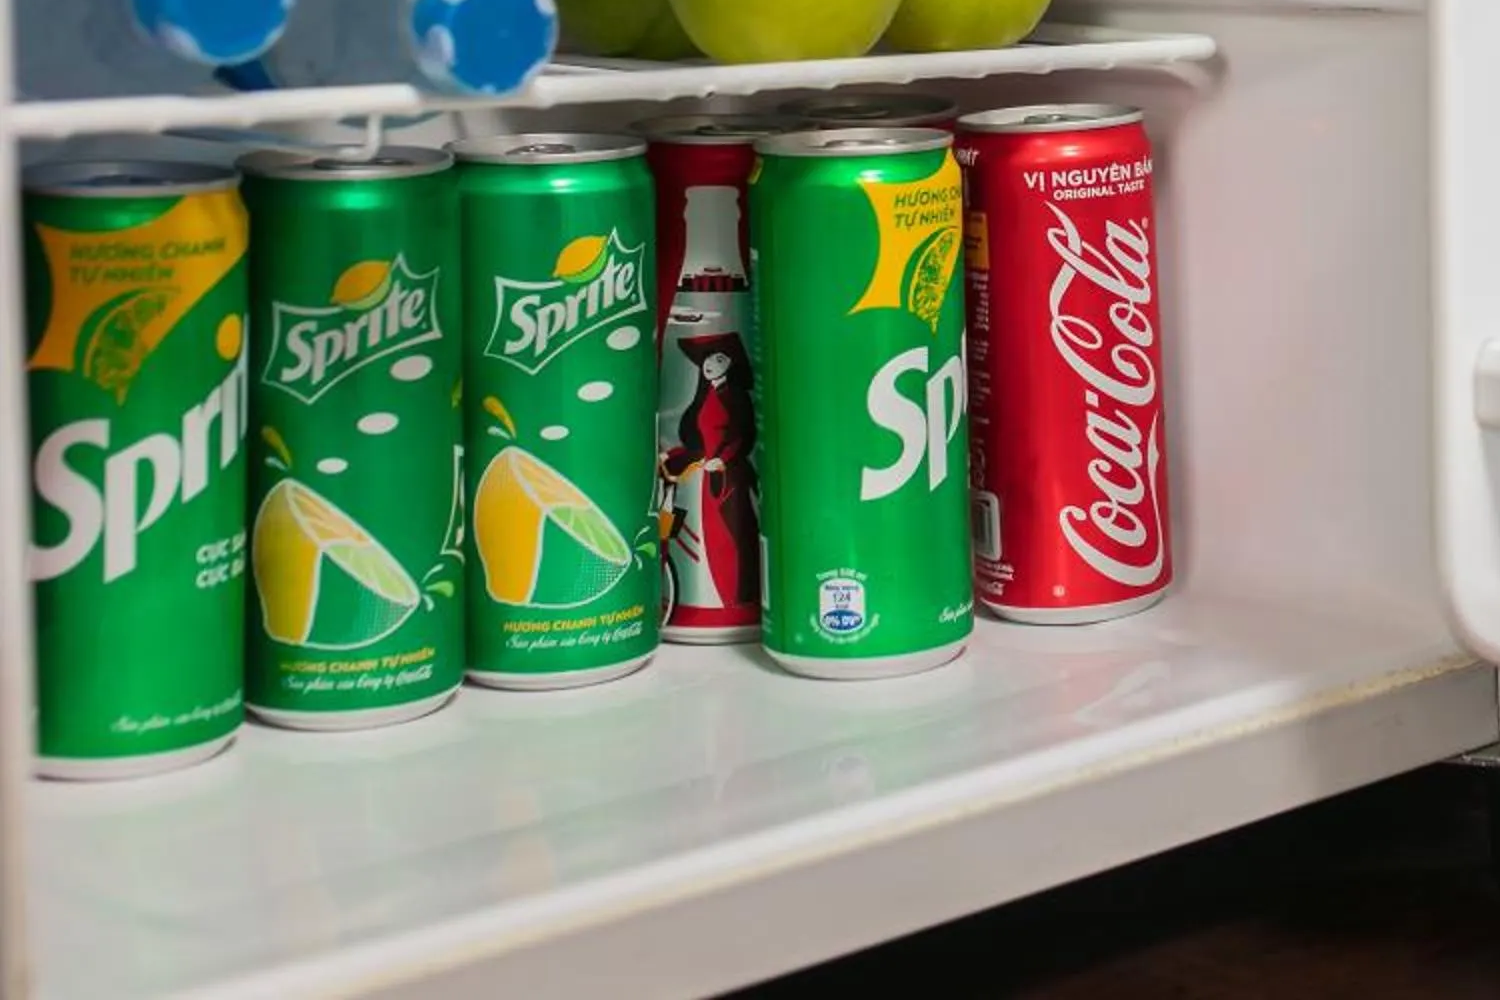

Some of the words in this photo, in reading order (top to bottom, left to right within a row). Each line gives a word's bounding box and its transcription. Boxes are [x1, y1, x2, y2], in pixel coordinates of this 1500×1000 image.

[1023, 171, 1045, 192] VỊ
[1052, 162, 1131, 188] NGUYÊN
[1053, 186, 1116, 201] ORIGINAL
[1117, 180, 1145, 194] TASTE
[279, 280, 427, 386] Sprite
[503, 254, 635, 358] Sprite
[859, 327, 969, 502] Sp
[1045, 200, 1163, 587] Coca-Cola
